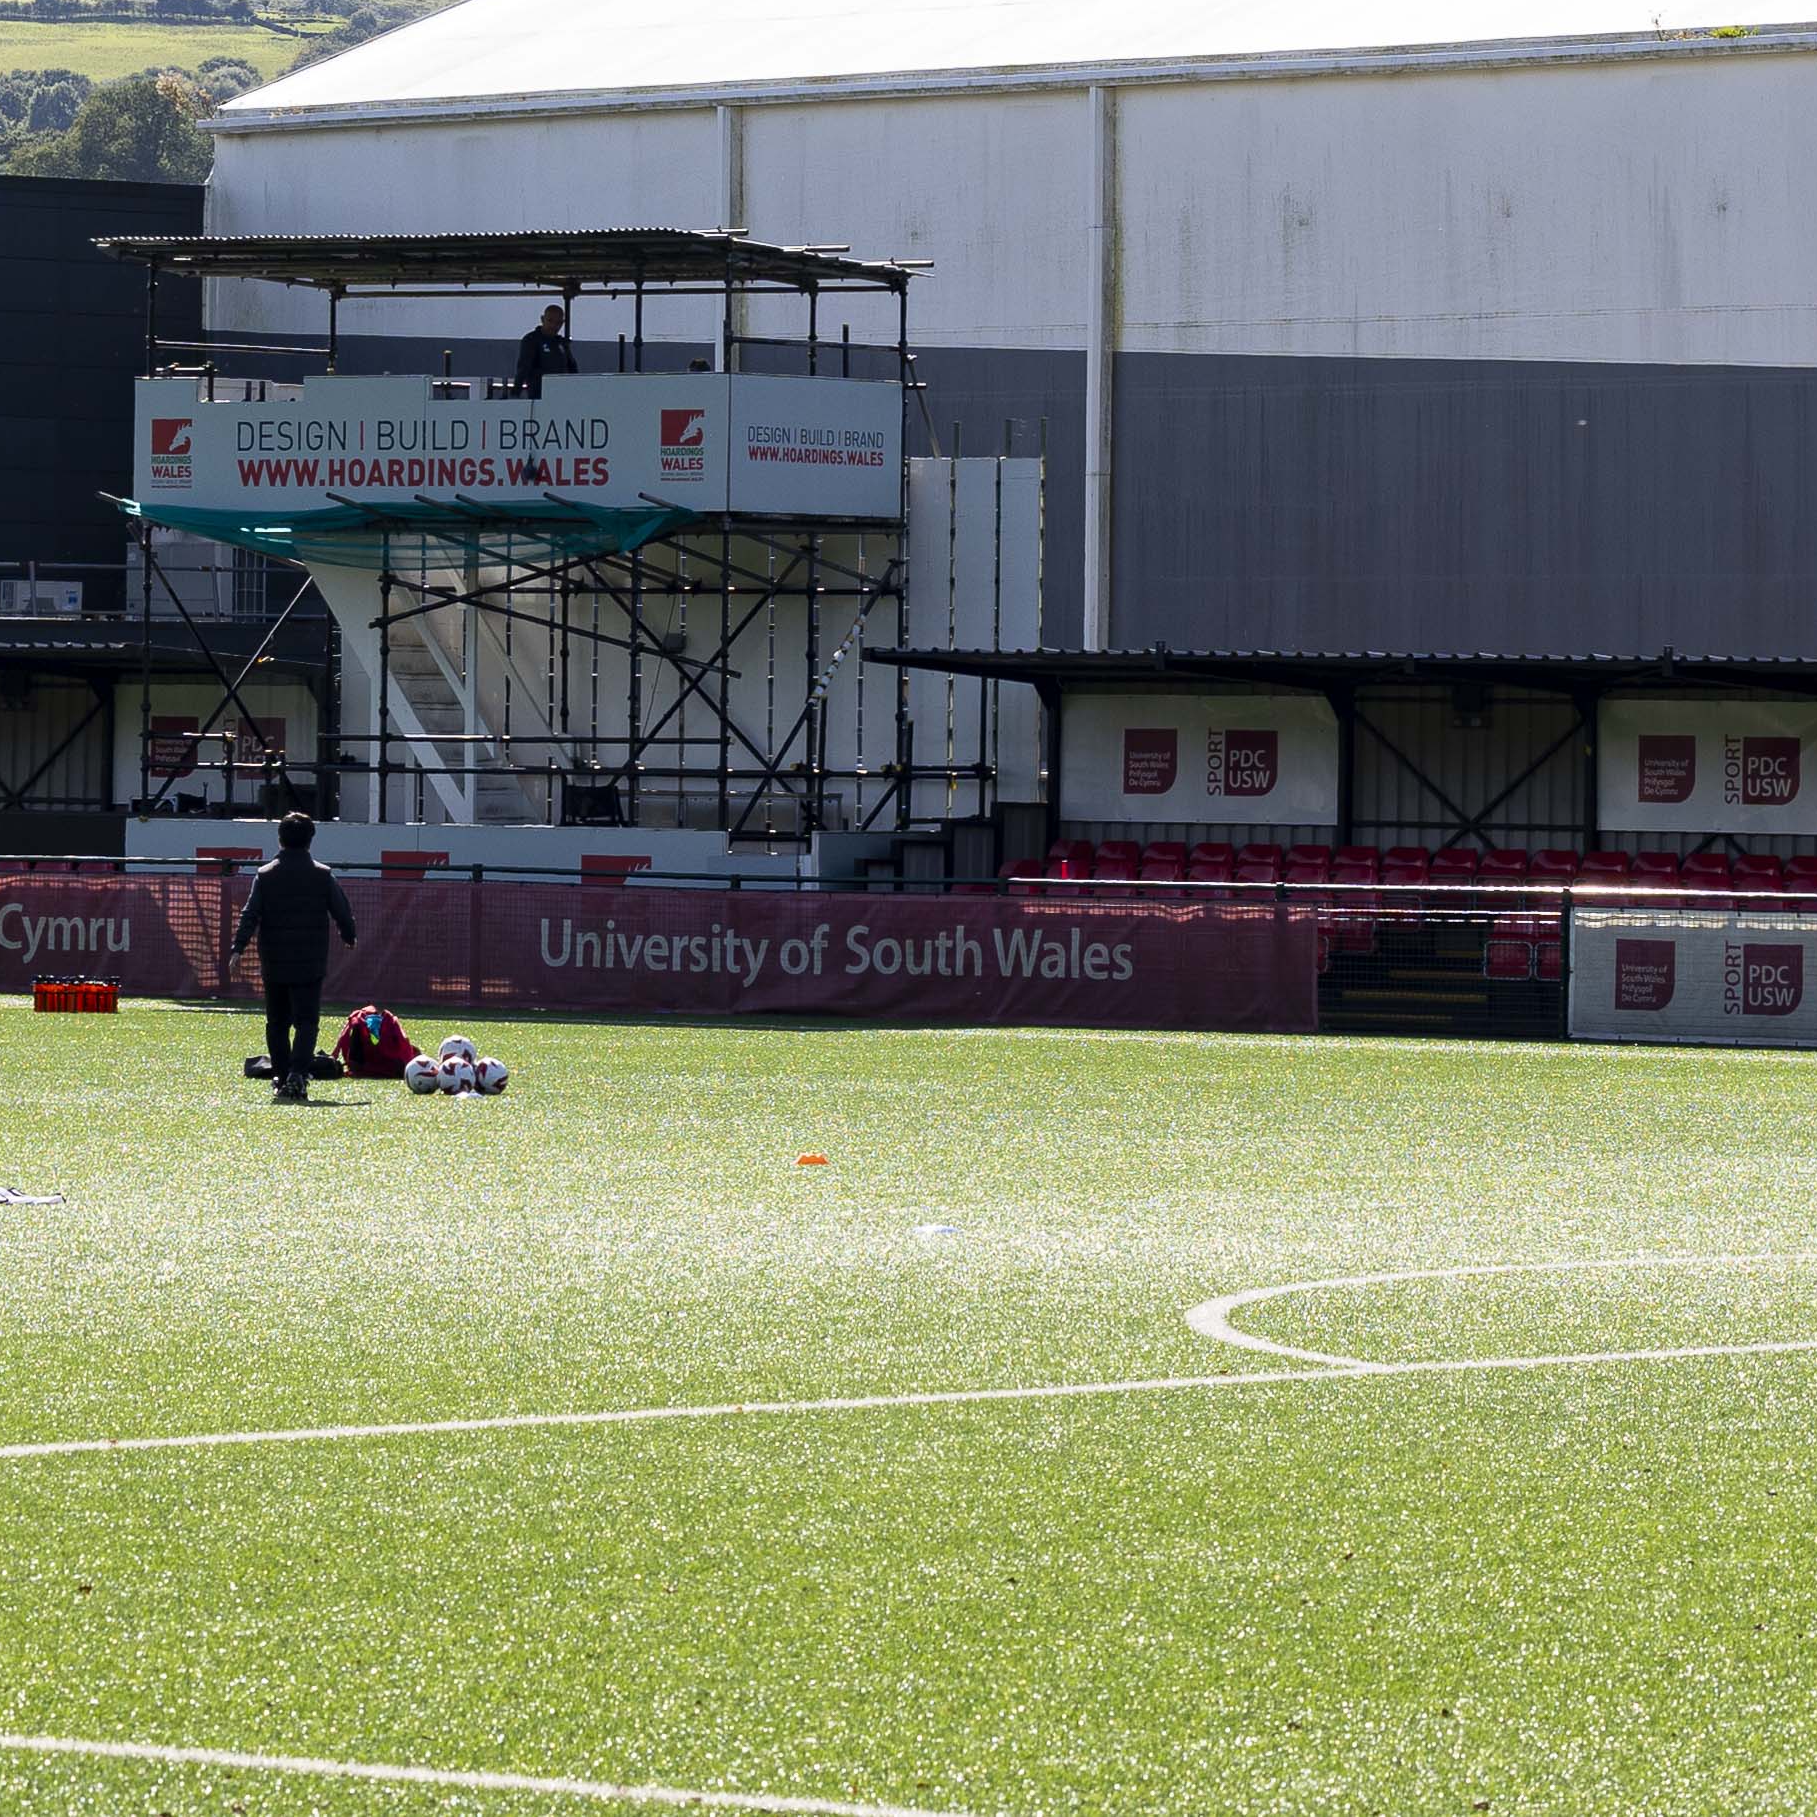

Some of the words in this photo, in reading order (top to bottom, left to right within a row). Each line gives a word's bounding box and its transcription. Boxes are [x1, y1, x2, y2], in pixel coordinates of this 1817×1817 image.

[238, 421, 347, 451] DESIGN
[377, 420, 469, 450] BUILD
[499, 419, 609, 450] BRAND
[748, 426, 790, 443] DESIGN
[800, 429, 834, 446] BUILD
[845, 431, 884, 448] BRAND
[151, 456, 192, 464] HOARDINGS
[660, 448, 703, 456] HOARDINGS
[748, 446, 883, 467] WWW.HOARDINGS.WALES
[152, 466, 191, 479] WALES
[237, 457, 609, 487] WWW.HOARDINGS.WALES
[661, 458, 703, 470] WALES
[1208, 727, 1222, 796] SPORT
[1231, 750, 1265, 767] PDC
[1748, 757, 1786, 775] PDC
[1725, 734, 1740, 804] SPORT
[1230, 771, 1269, 788] USW
[1748, 778, 1791, 797] USW
[540, 918, 768, 987] University
[781, 924, 829, 976] of
[845, 925, 982, 977] South
[993, 927, 1133, 980] Wales
[1725, 941, 1741, 1014] SPORT
[1749, 966, 1789, 984] PDC
[1749, 987, 1794, 1006] USW
